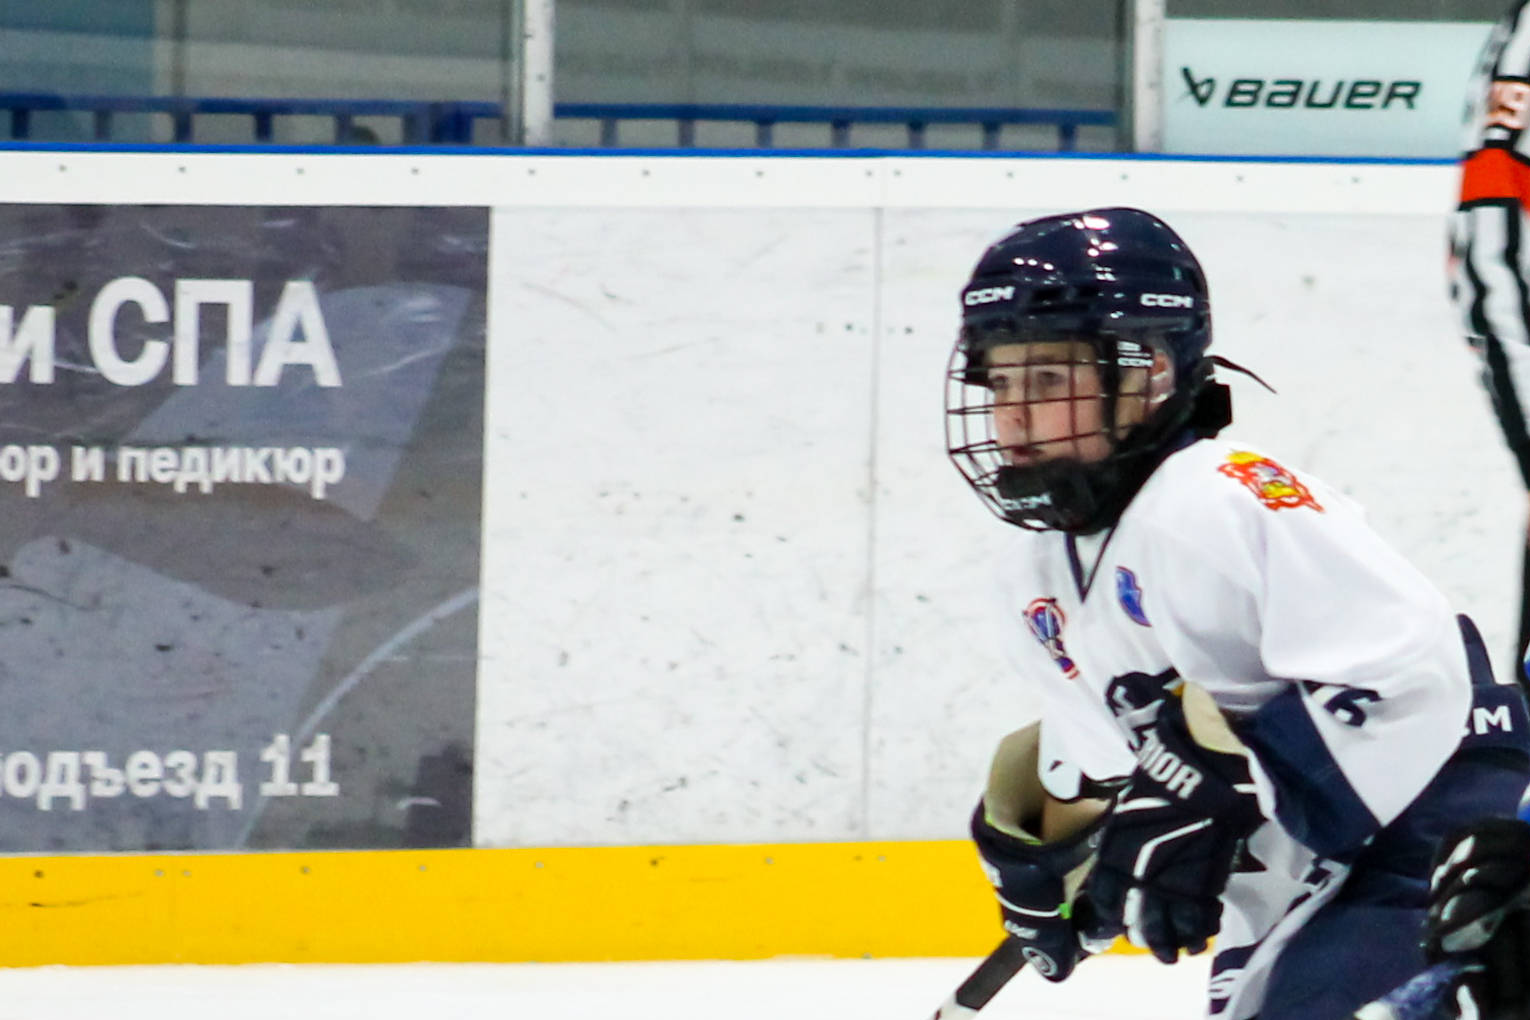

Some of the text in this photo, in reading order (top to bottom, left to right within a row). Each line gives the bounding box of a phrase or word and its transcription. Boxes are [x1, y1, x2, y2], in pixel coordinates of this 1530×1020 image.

[964, 286, 1015, 305] CCM
[1140, 293, 1194, 308] CCM
[89, 276, 343, 387] СПА
[71, 447, 104, 482] и
[117, 446, 346, 499] педикюр
[0, 733, 340, 811] одъезд 11
